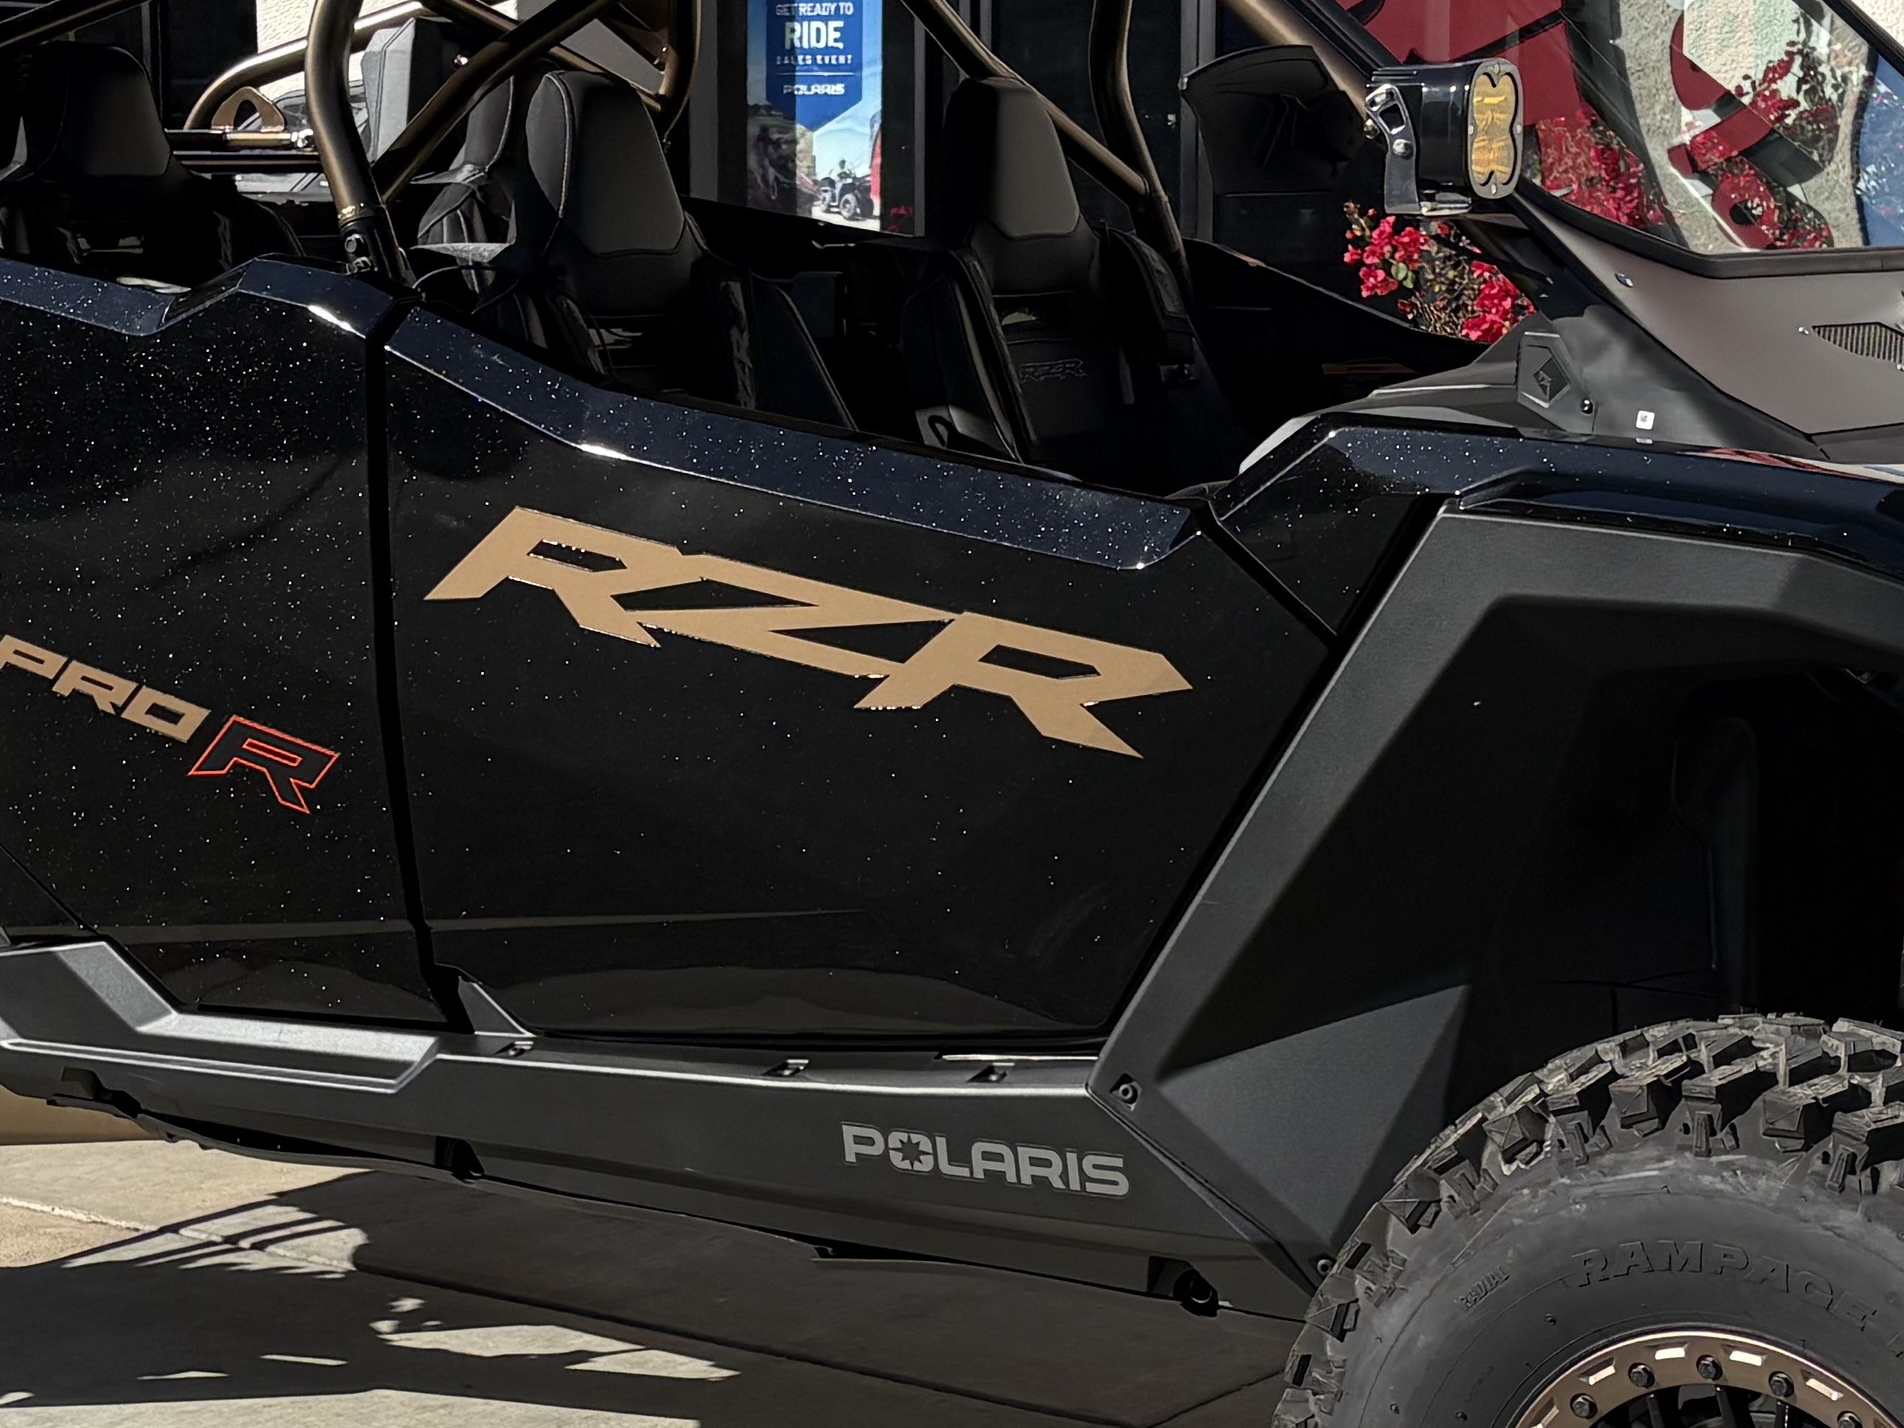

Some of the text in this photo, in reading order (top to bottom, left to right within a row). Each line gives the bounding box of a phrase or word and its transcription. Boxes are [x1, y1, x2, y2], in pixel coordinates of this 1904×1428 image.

[785, 20, 844, 50] RIDE
[798, 3, 837, 16] READY
[839, 2, 854, 15] TO
[783, 83, 845, 95] POLARIS
[424, 505, 1193, 758] RZR
[188, 715, 340, 814] R
[840, 1121, 1131, 1198] POLARIS
[1571, 1240, 1878, 1332] RAMPAGE
